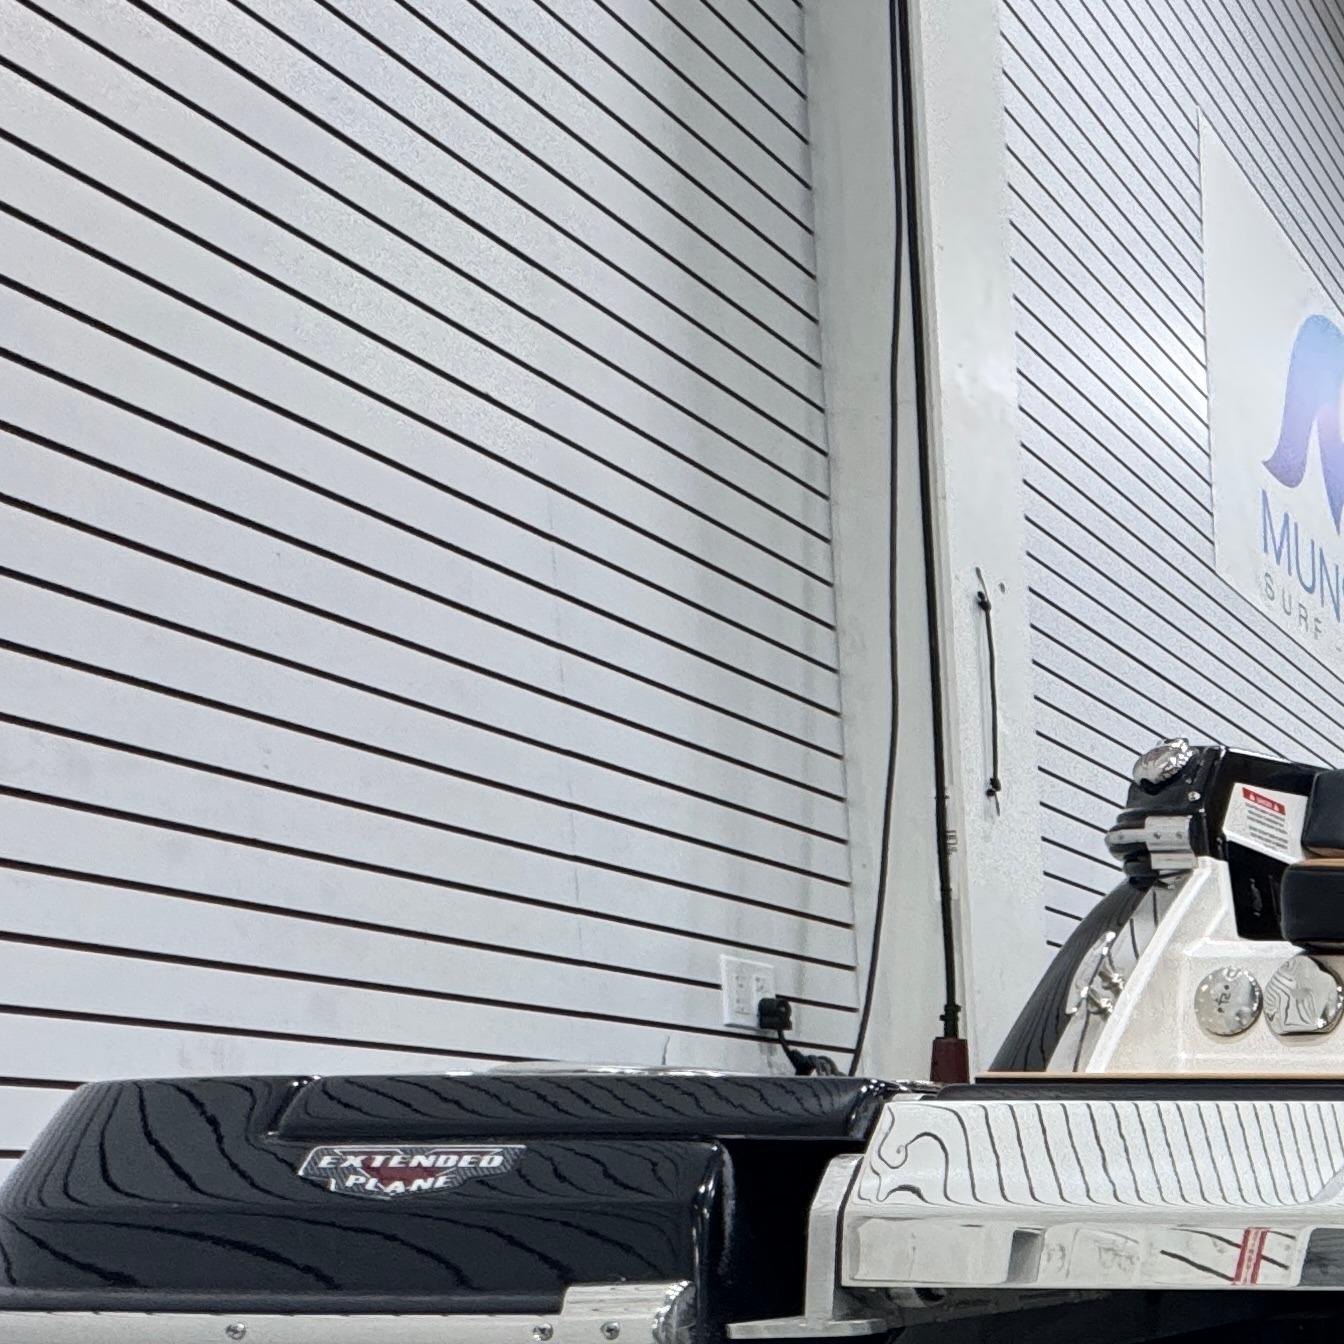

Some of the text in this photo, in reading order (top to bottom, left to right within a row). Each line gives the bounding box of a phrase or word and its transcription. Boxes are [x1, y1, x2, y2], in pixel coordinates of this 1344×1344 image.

[1264, 572, 1322, 640] SURF
[318, 1154, 504, 1168] EXTENDED
[345, 1174, 456, 1194] PLANE
